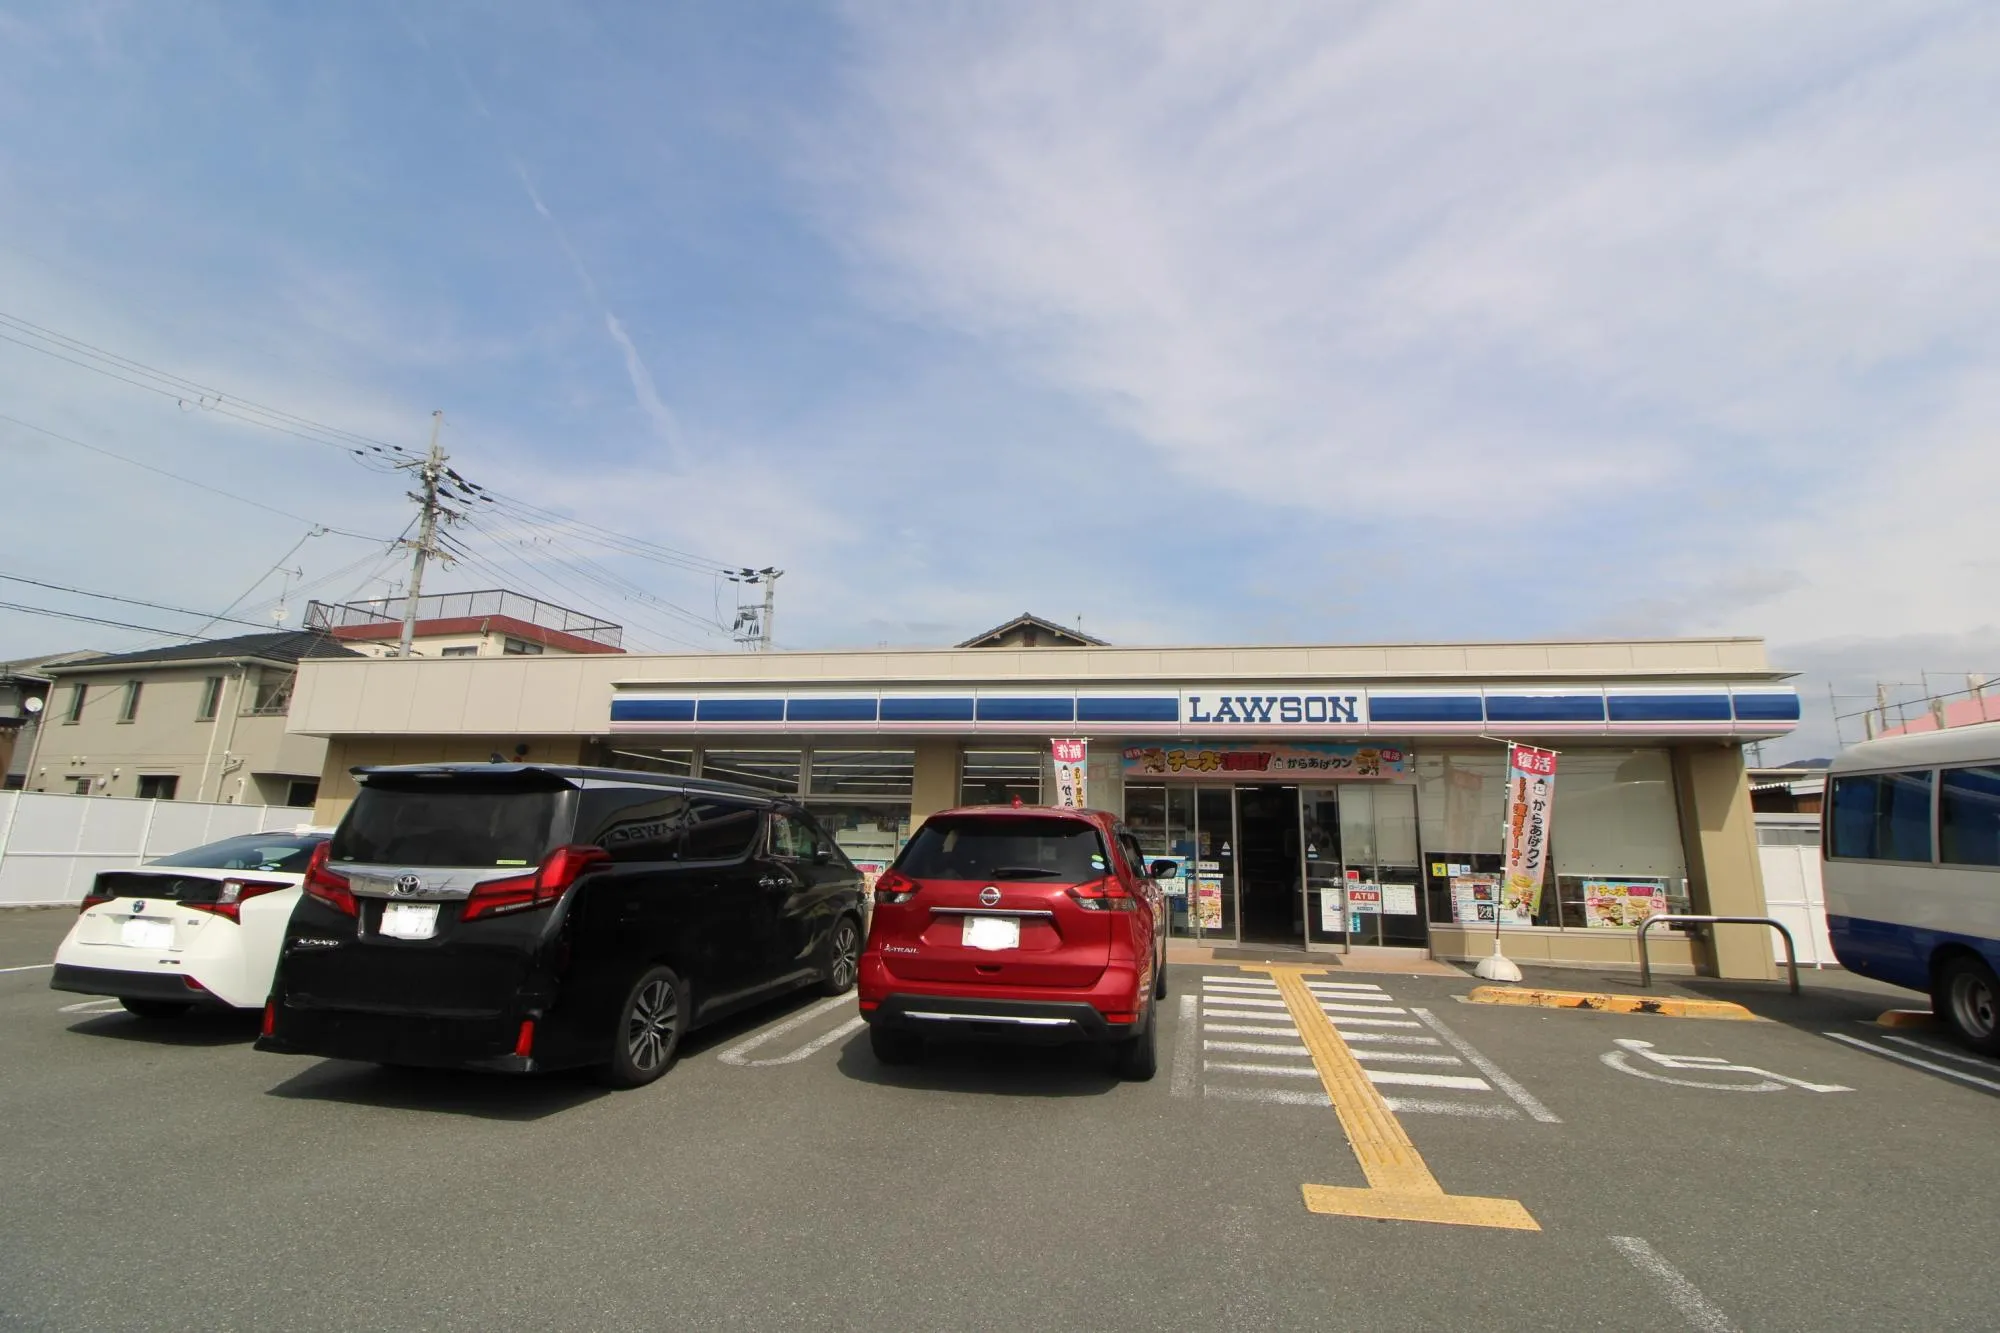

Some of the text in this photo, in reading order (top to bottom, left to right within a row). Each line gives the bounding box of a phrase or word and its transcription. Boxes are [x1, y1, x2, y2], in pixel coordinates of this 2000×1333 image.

[1189, 696, 1358, 723] LAWSON
[1287, 758, 1353, 770] からあげクン
[1517, 751, 1552, 773] 復活
[1525, 798, 1546, 870] からあげクン
[1354, 892, 1375, 900] ATM
